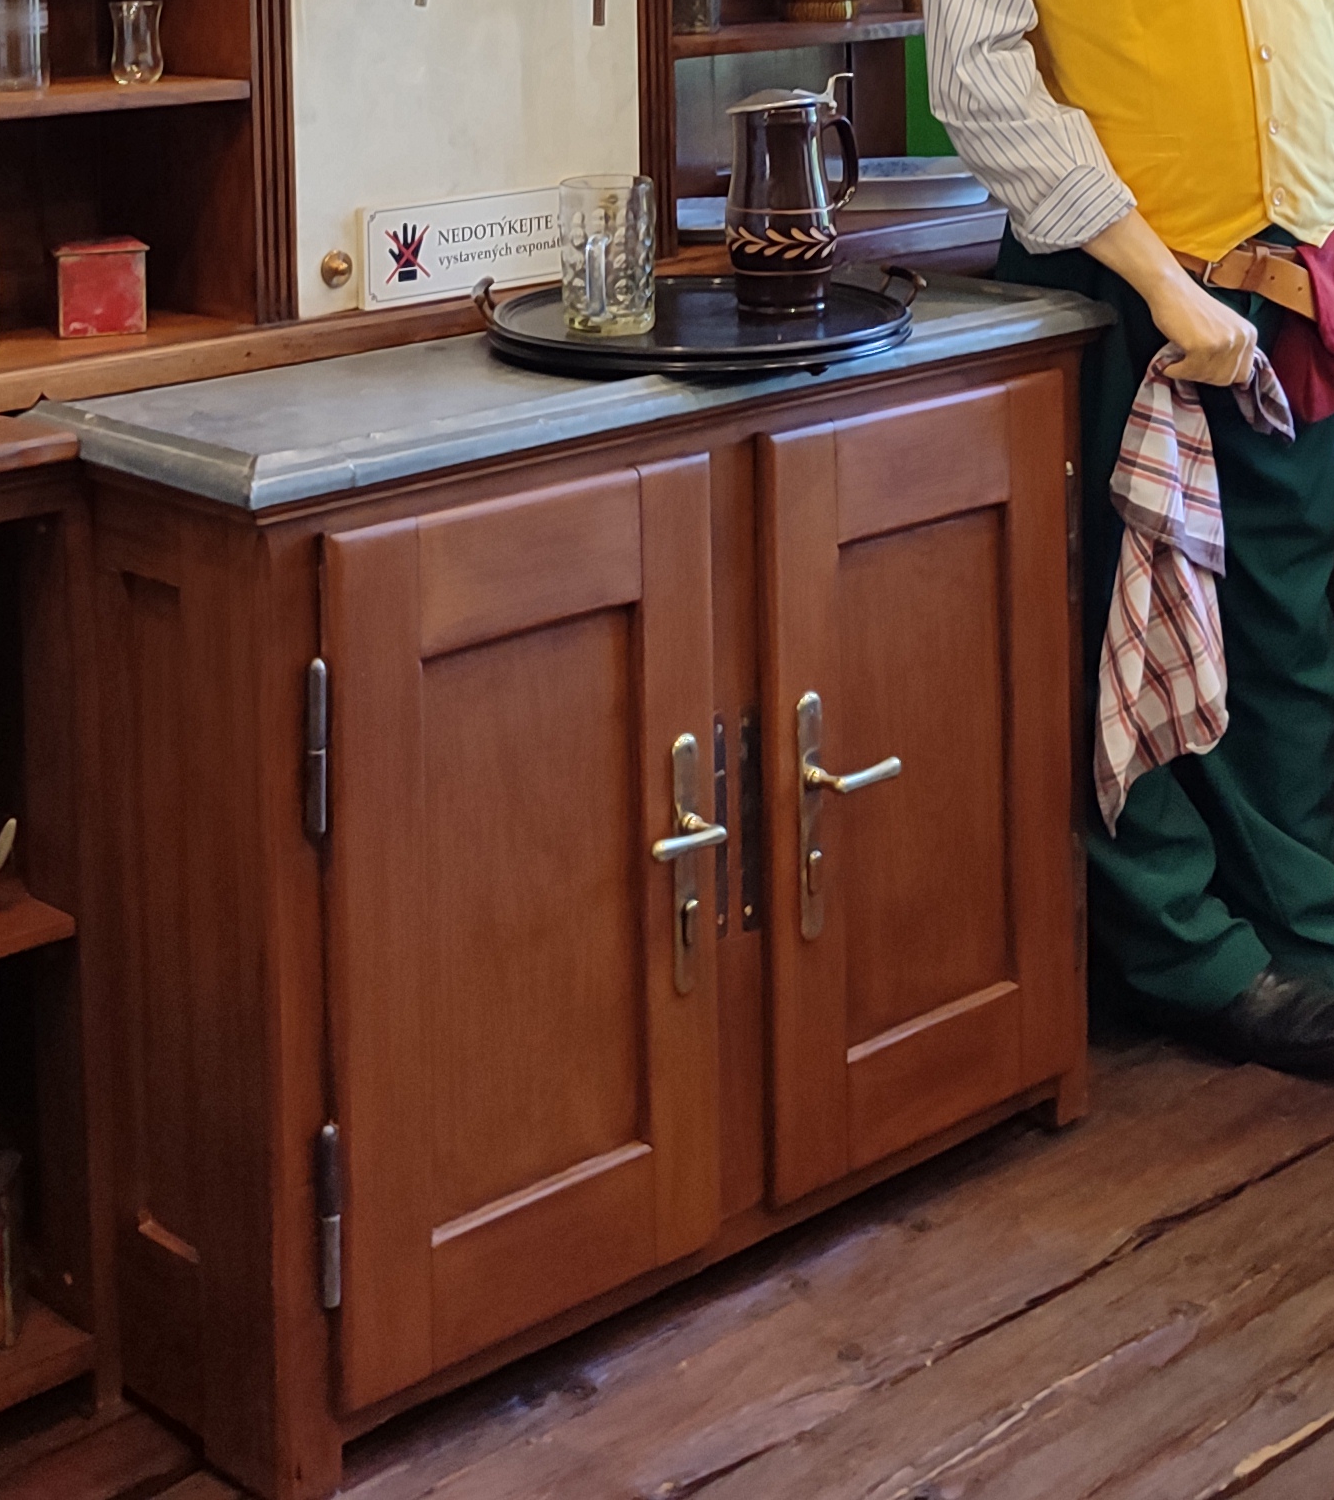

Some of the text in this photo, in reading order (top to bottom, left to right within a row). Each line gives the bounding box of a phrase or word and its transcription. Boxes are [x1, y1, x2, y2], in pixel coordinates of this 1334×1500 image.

[437, 215, 553, 246] NEDOTÝKEJTE
[438, 235, 563, 270] vystavených exponát
